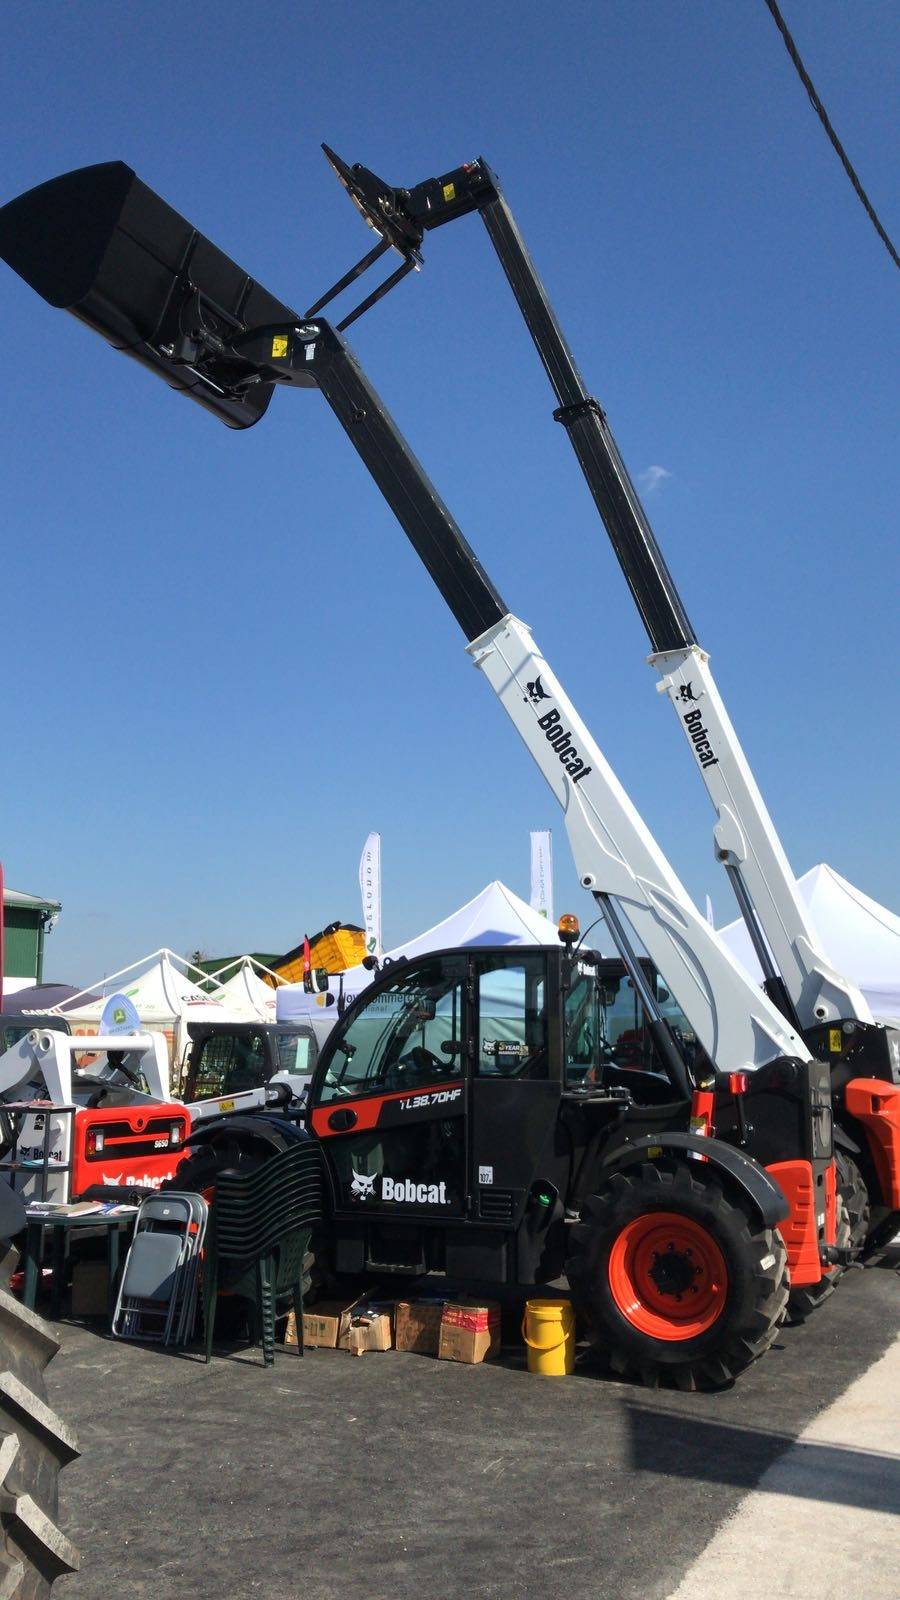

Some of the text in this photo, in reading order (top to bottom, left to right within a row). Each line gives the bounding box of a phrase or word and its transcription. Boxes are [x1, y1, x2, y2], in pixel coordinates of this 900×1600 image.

[537, 708, 592, 784] Bobcat
[683, 708, 719, 769] Bobcat
[33, 1148, 62, 1162] Bocat
[153, 1139, 169, 1148] S650
[382, 1177, 447, 1204] Bobcat
